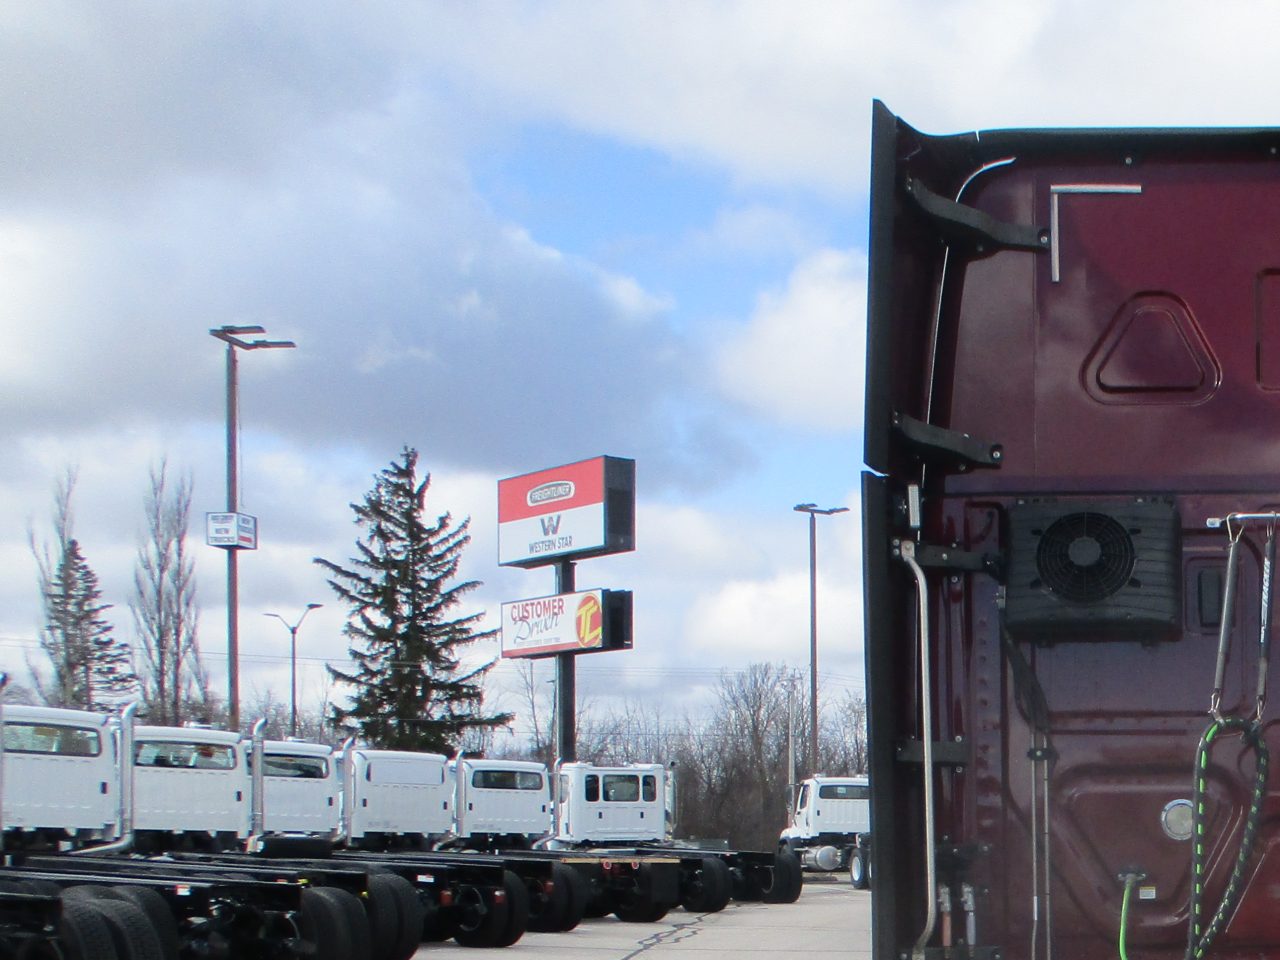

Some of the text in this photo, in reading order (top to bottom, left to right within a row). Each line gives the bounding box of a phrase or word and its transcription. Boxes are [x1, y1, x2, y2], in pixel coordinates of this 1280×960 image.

[531, 485, 569, 501] FREIGHTLINER
[528, 535, 573, 555] WESTERN STAR
[511, 598, 565, 620] CUSTOMER
[513, 612, 559, 641] Driven
